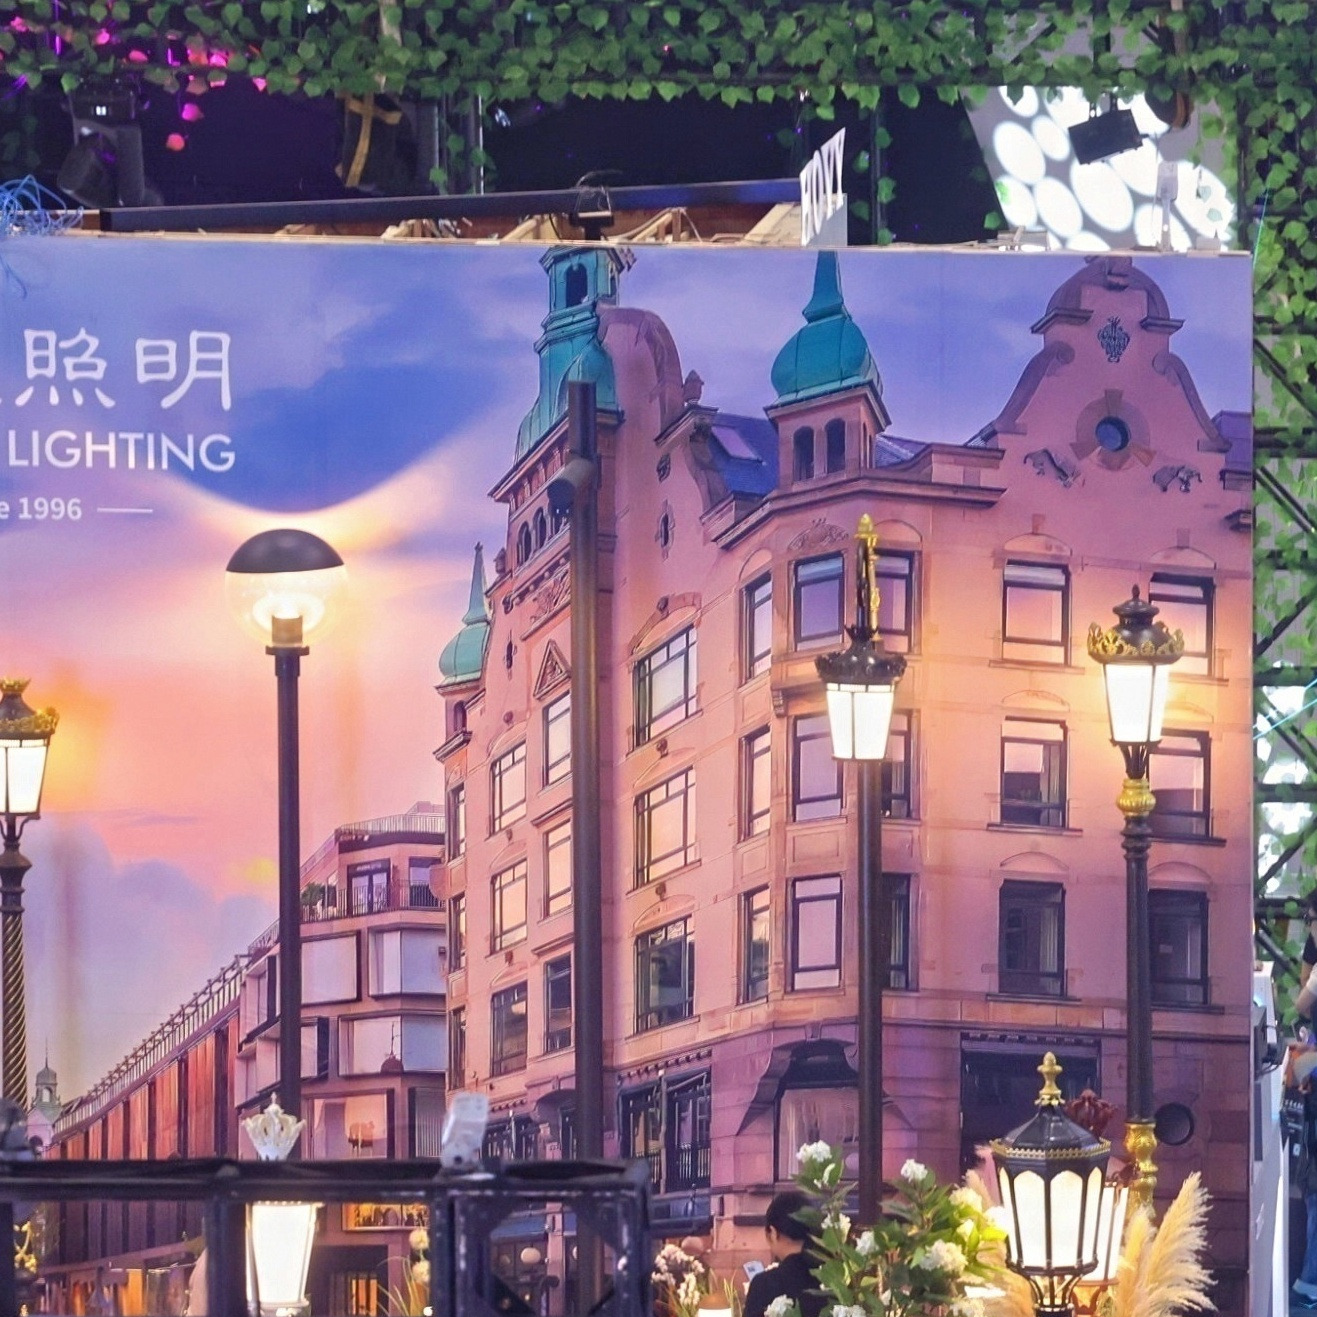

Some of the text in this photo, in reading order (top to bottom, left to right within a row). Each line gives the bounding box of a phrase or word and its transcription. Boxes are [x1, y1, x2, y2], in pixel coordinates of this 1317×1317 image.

[14, 326, 233, 411] 照明
[8, 429, 237, 472] LIGHTING
[18, 497, 83, 520] 1996
